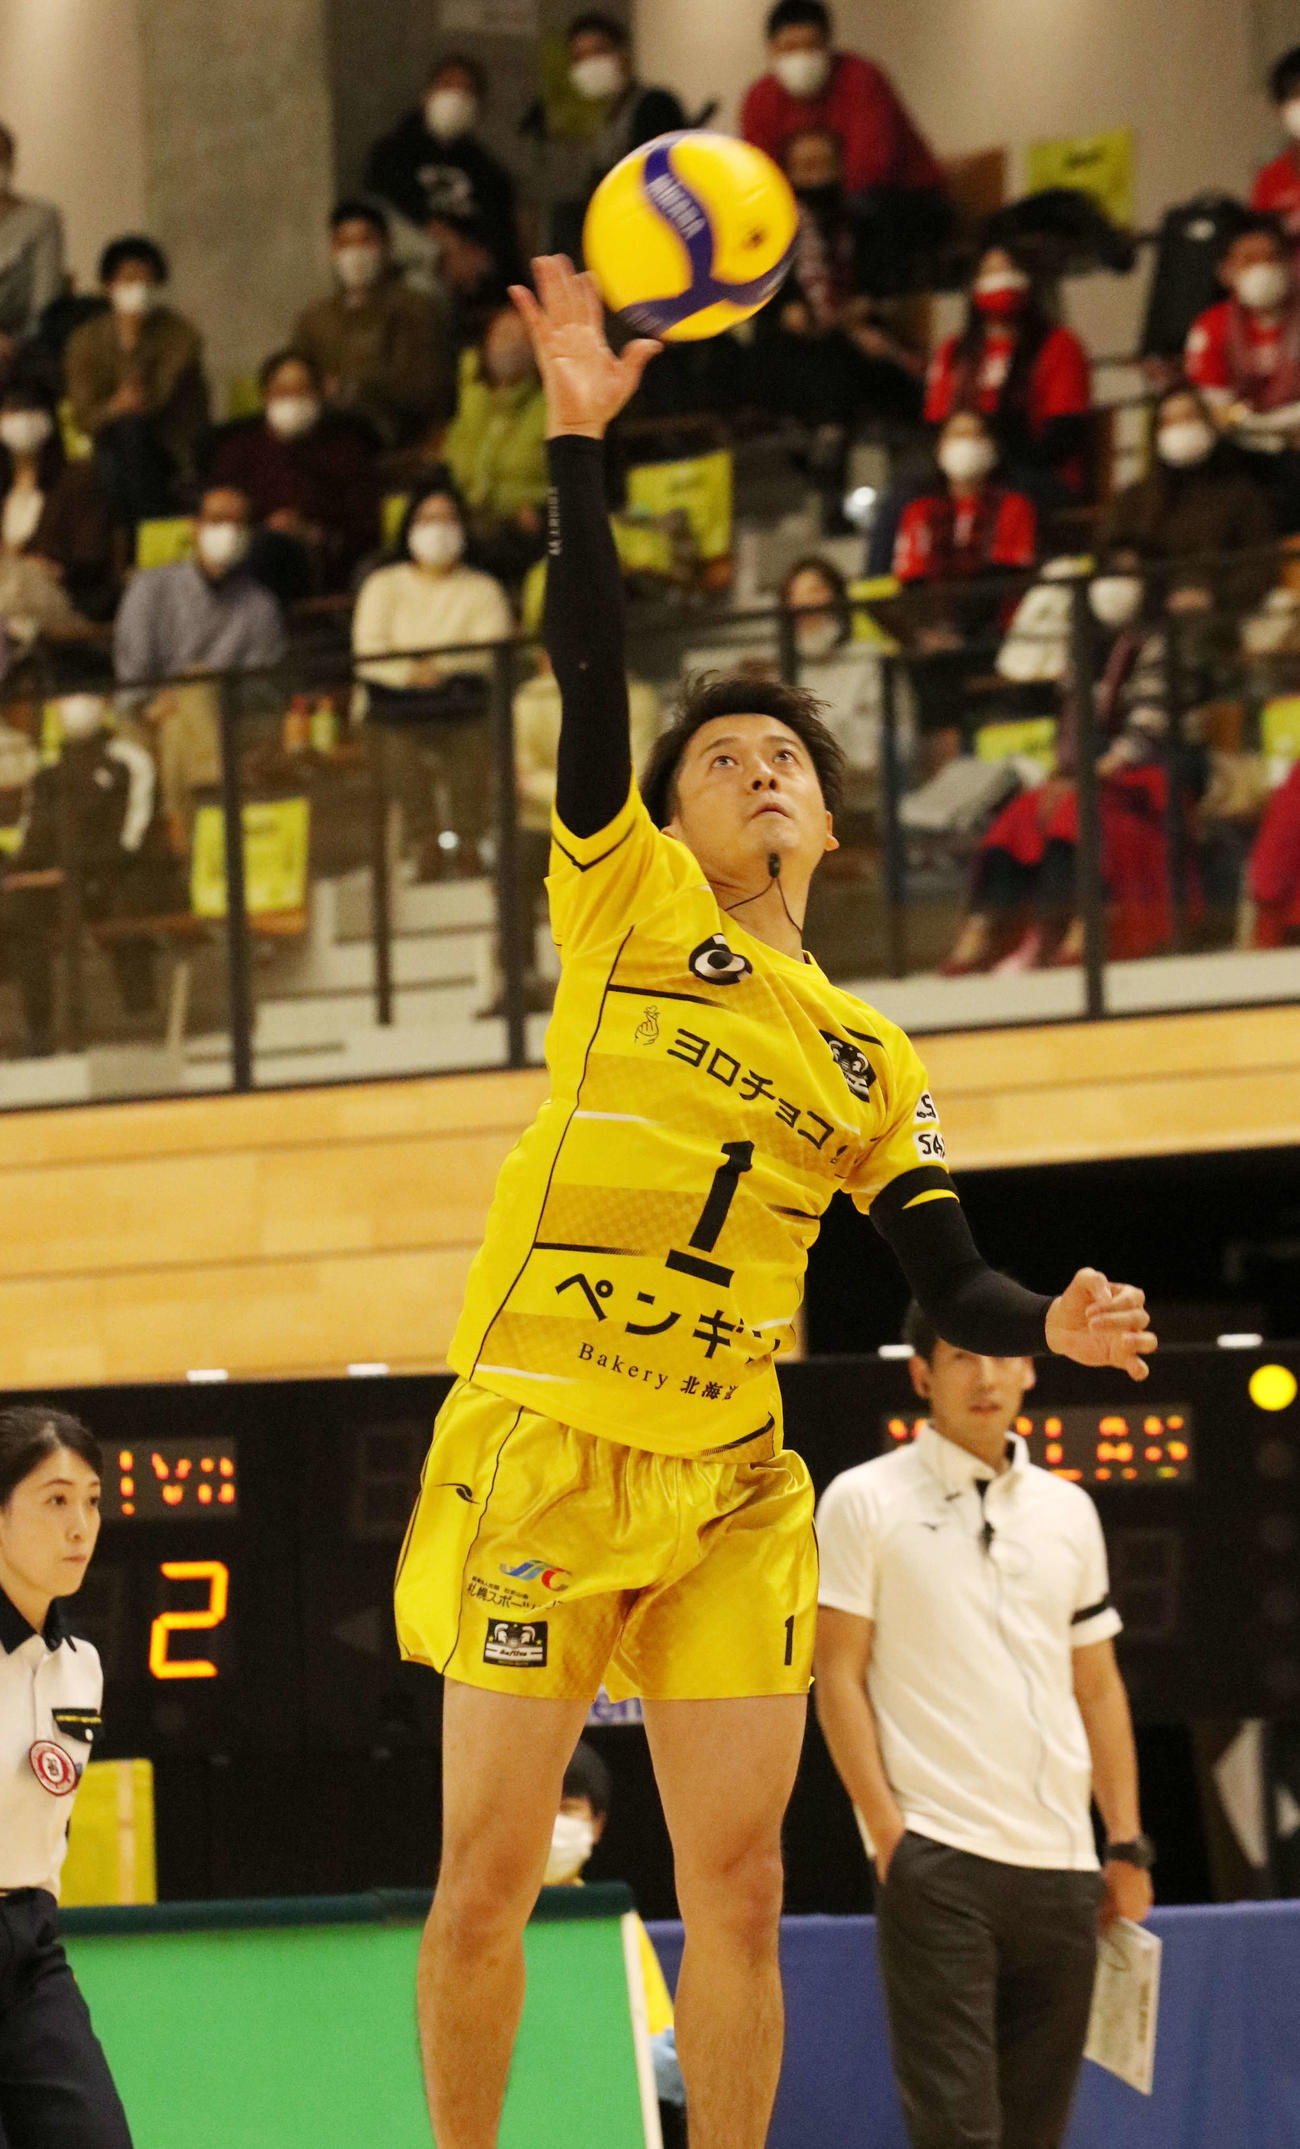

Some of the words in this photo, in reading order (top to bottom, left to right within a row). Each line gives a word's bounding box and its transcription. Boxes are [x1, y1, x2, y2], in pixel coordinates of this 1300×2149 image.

[918, 1133, 945, 1158] SA
[665, 1140, 755, 1288] 1
[579, 1341, 669, 1390] Bakery
[149, 1561, 230, 1680] 2
[784, 1614, 795, 1666] 1
